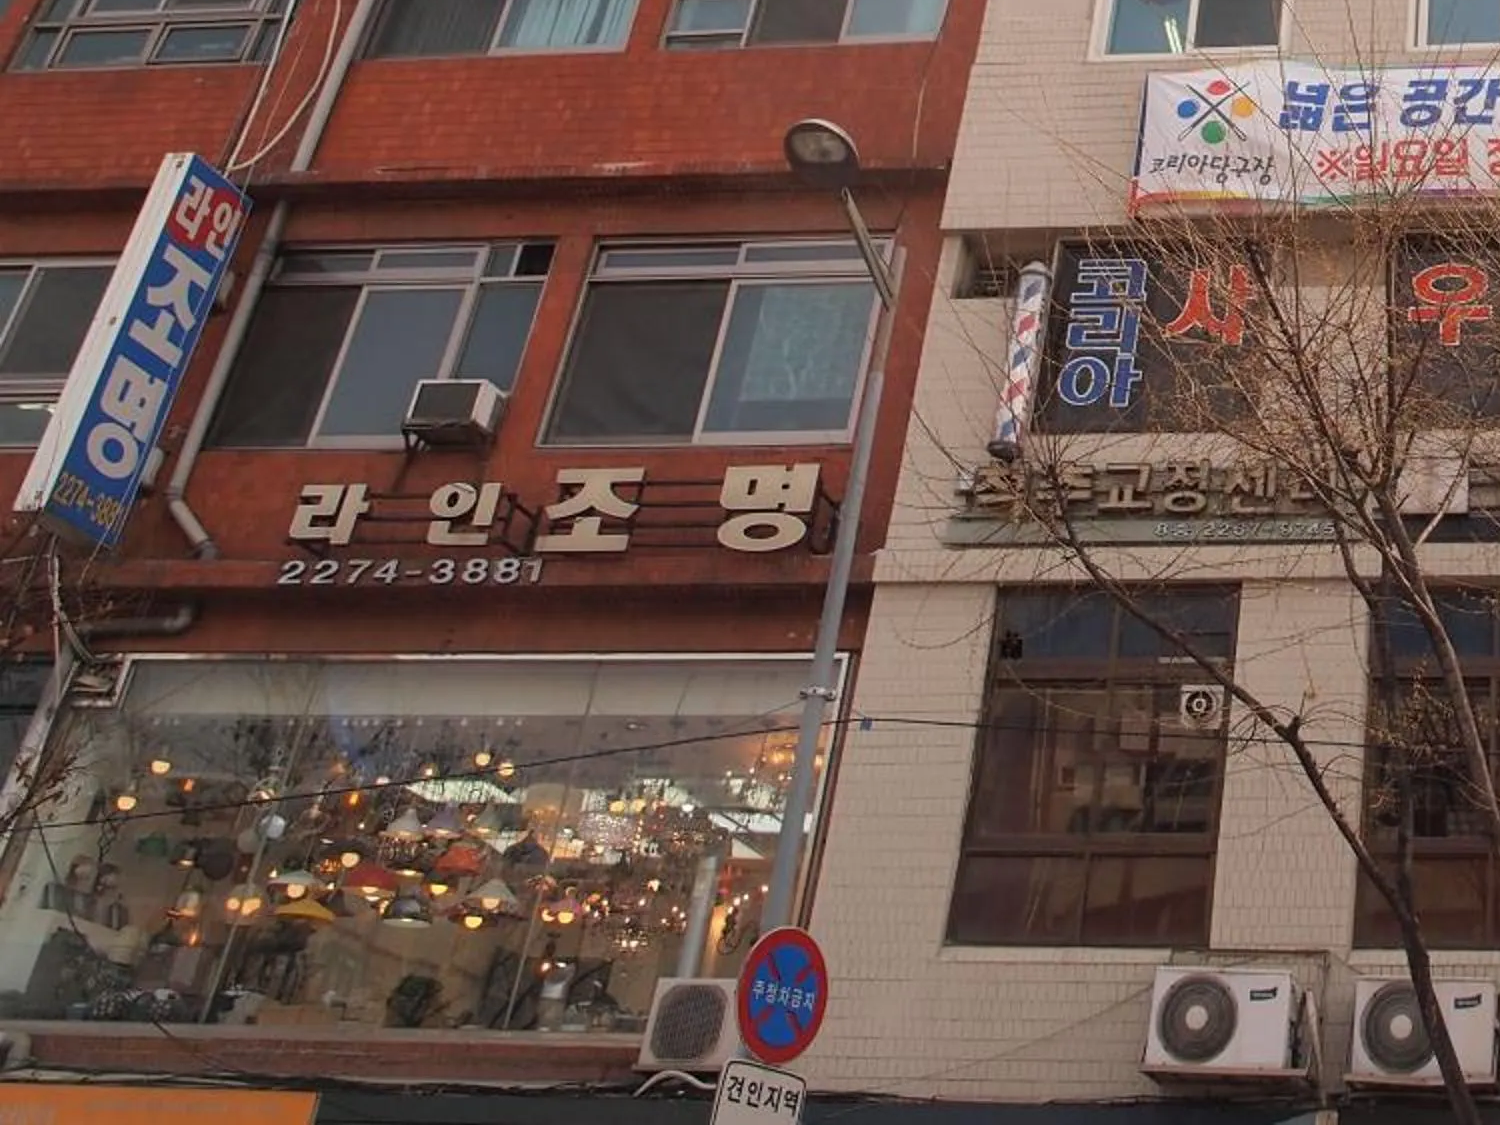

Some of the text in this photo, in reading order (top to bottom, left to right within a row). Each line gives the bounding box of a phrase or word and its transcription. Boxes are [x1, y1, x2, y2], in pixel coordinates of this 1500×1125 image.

[1279, 80, 1380, 132] 넓은
[1150, 152, 1276, 186] 코리아당구장
[174, 176, 242, 258] 라인
[1057, 259, 1147, 407] 코리아
[86, 243, 213, 481] 조명
[277, 558, 545, 586] 2274-3881
[752, 980, 815, 1011] 주정차금지
[726, 1075, 800, 1117] 견인지역
